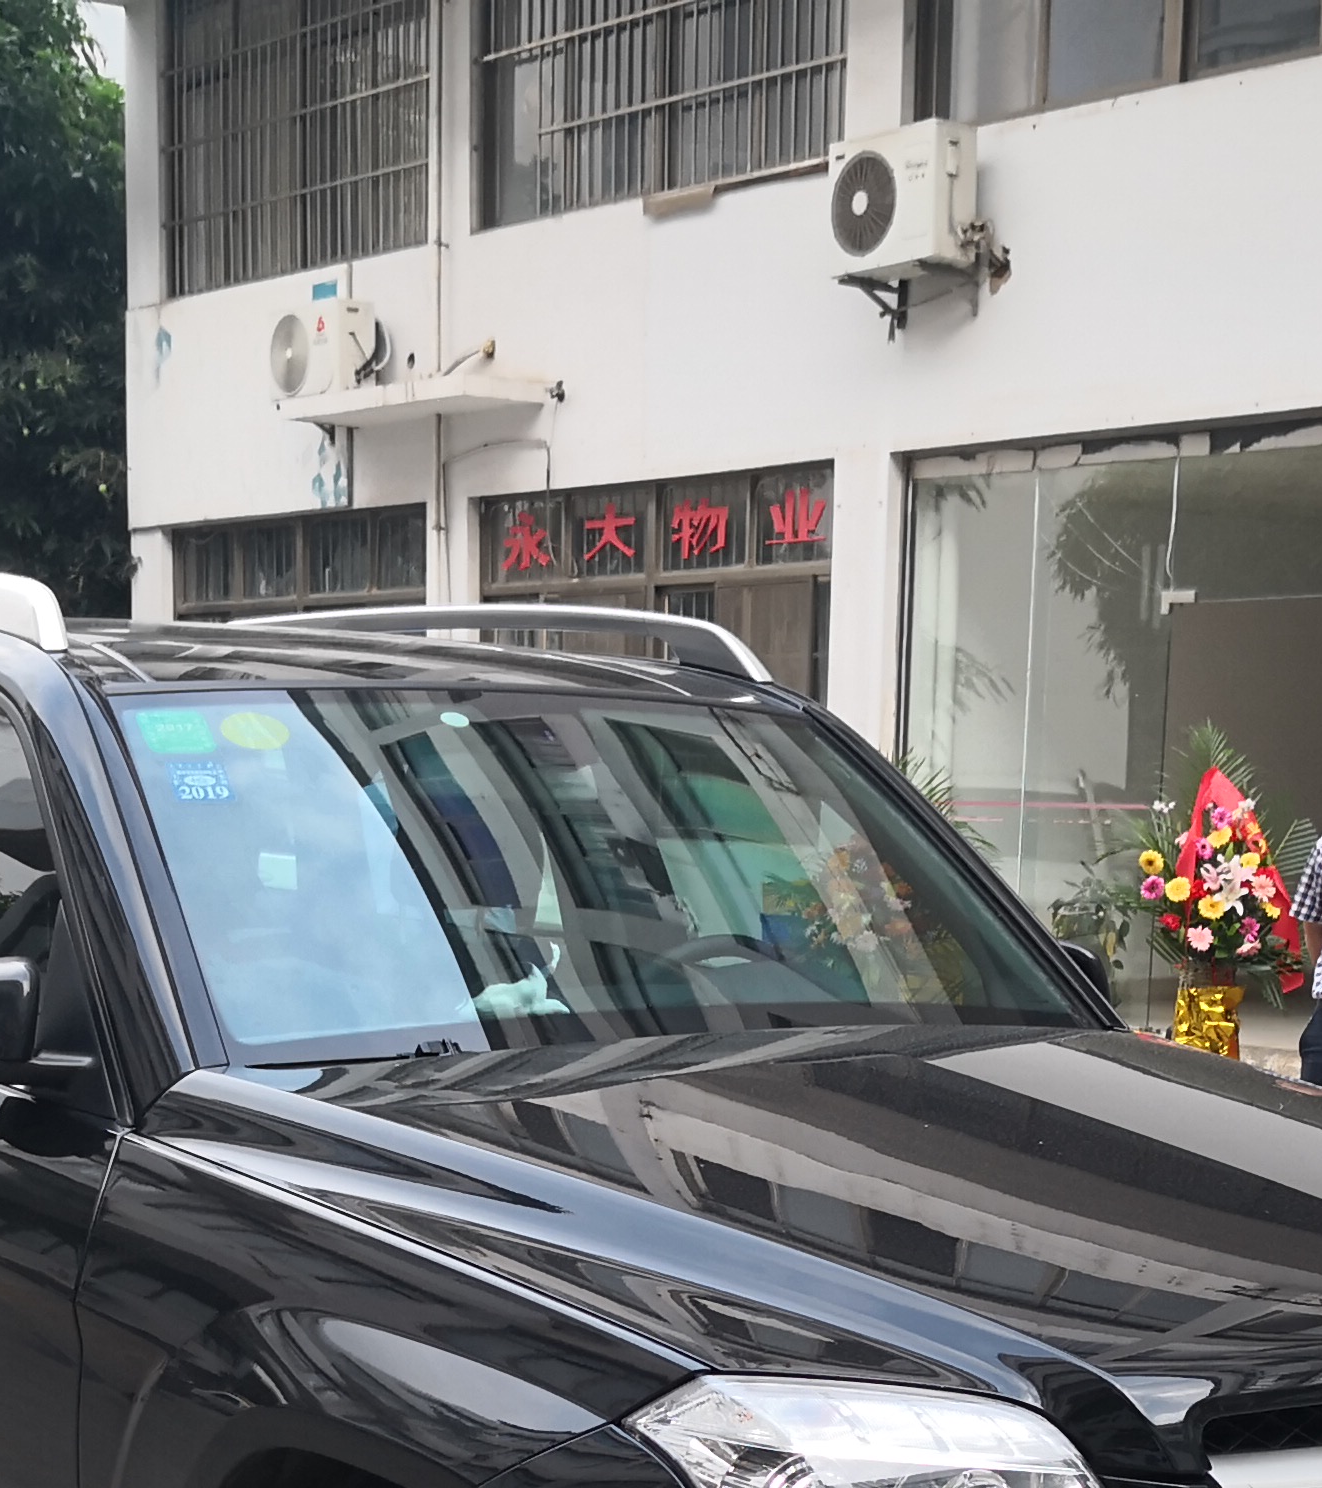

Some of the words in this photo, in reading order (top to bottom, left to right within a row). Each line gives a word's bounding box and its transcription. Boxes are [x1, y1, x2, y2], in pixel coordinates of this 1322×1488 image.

[502, 487, 827, 572] 永大物业
[178, 785, 230, 800] 2019
